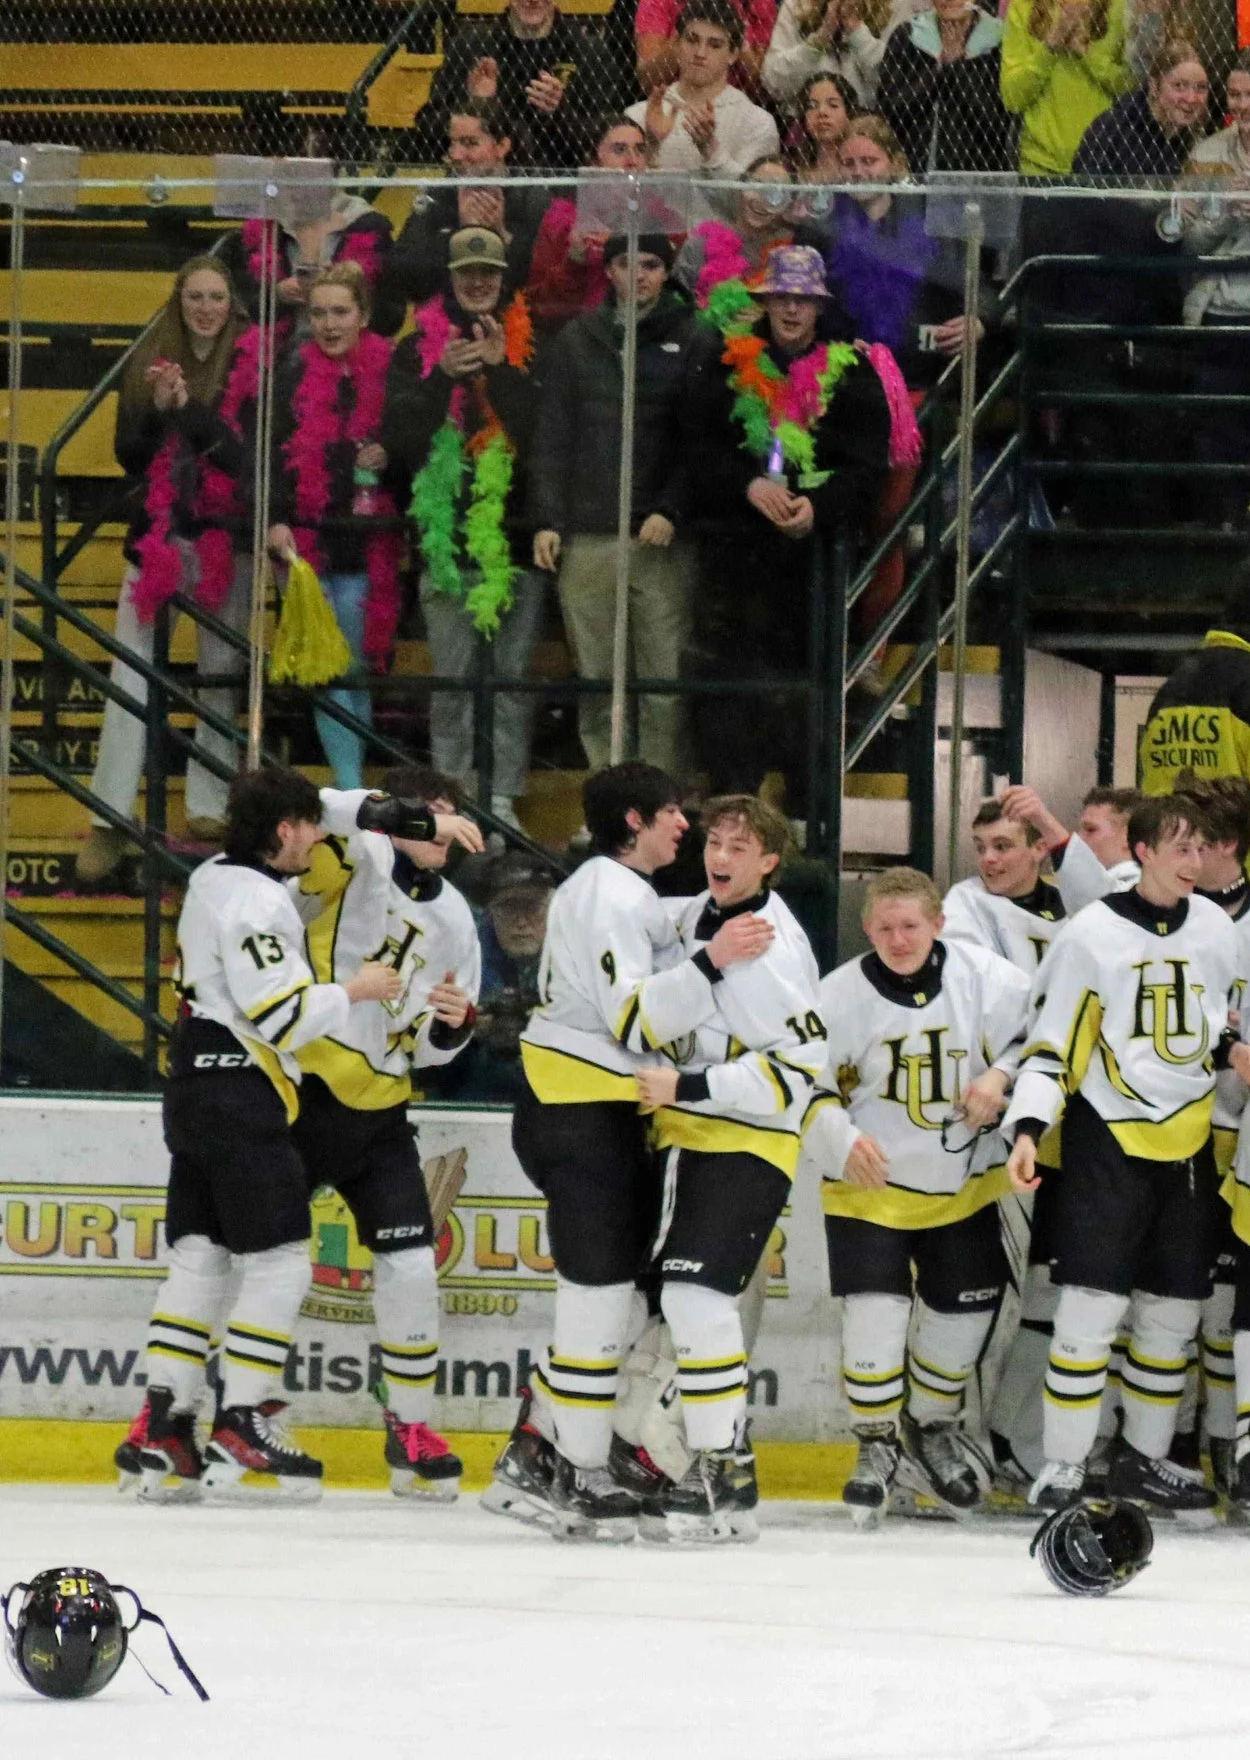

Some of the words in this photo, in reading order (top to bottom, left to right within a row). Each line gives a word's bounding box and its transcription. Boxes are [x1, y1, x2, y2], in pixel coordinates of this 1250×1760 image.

[1152, 713, 1220, 745] GMCS
[240, 932, 286, 971] 13
[600, 949, 617, 987] 9
[786, 1009, 828, 1045] 14
[1129, 958, 1211, 1066] HU
[193, 1053, 258, 1068] CC
[879, 1027, 969, 1131] HU
[375, 1225, 425, 1240] CCM
